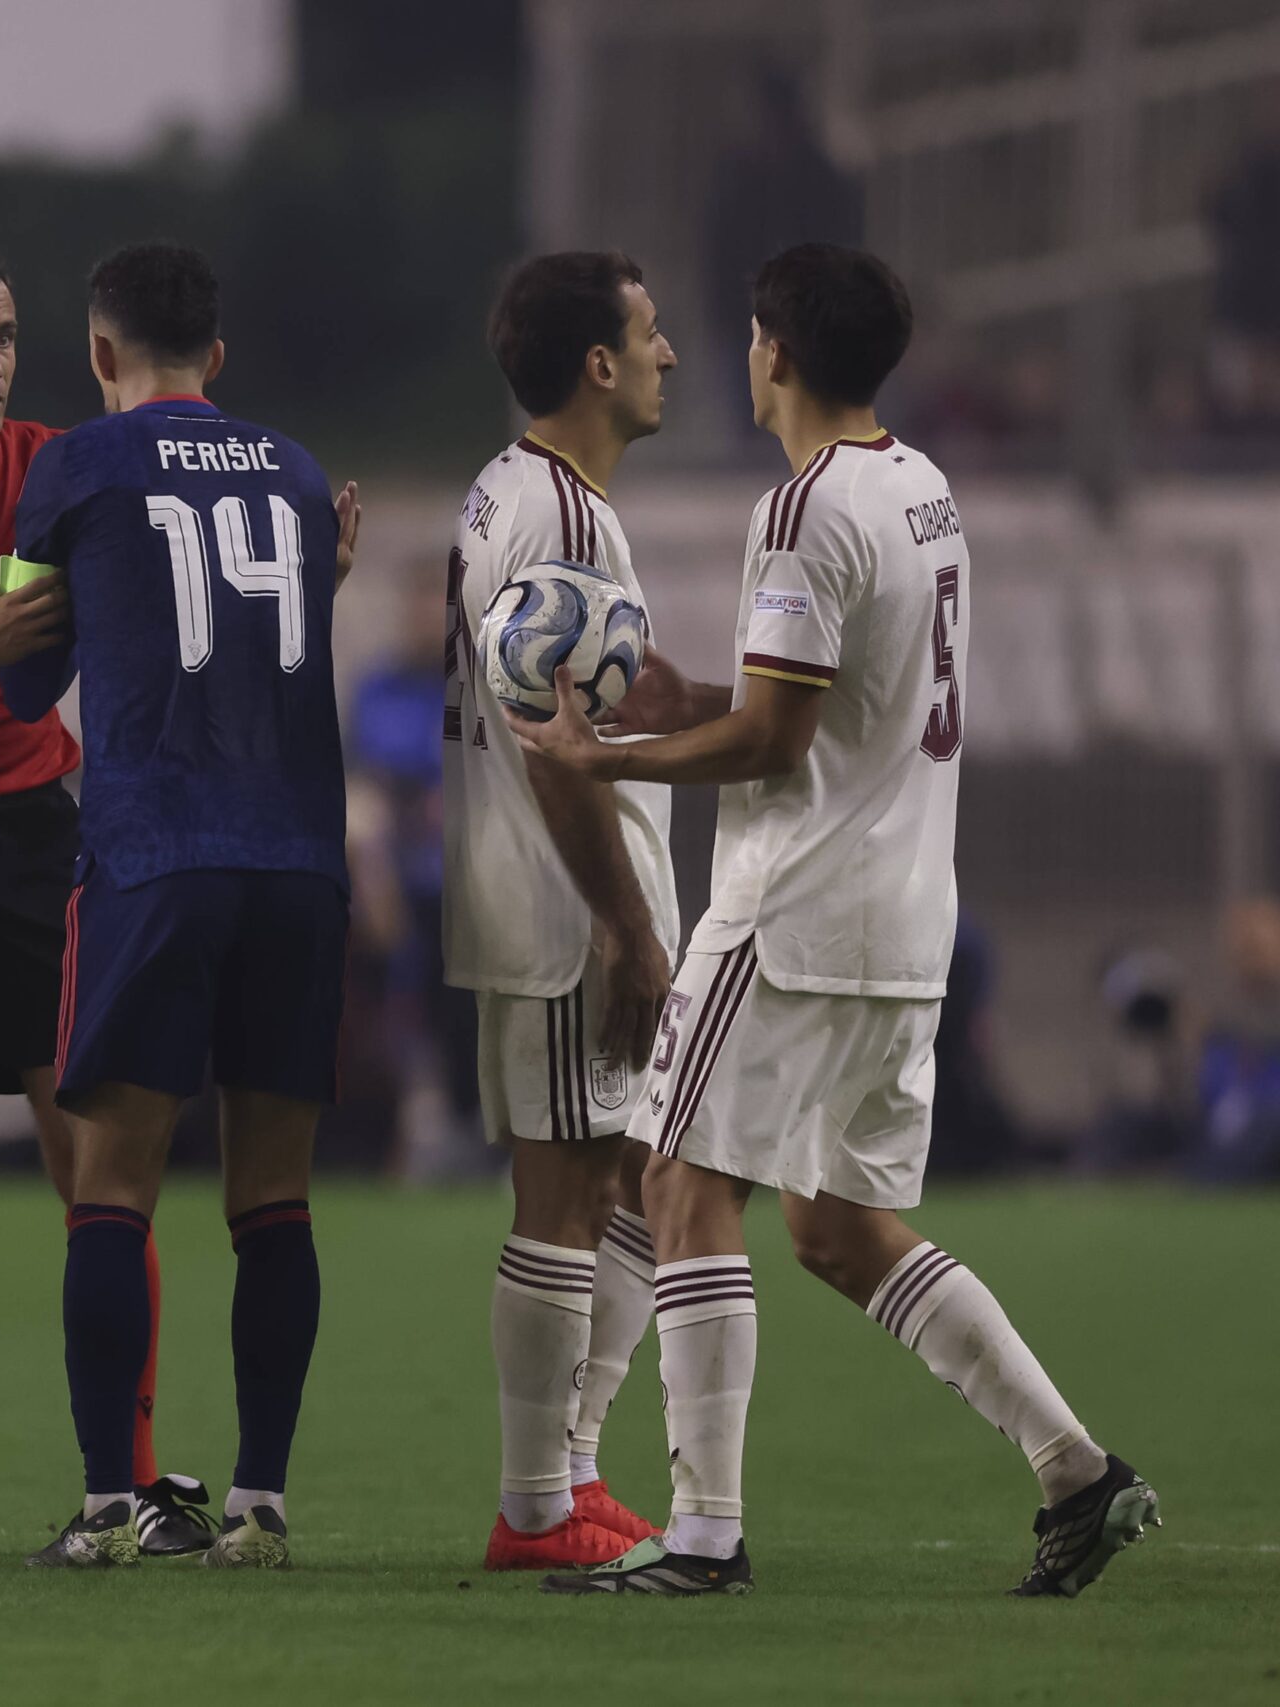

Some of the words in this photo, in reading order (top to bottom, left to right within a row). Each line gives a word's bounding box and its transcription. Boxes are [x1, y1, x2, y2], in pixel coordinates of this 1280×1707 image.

[157, 437, 280, 471] PERIŠIĆ
[905, 486, 960, 546] CUBARS
[145, 495, 304, 673] 14
[919, 564, 963, 763] 5
[652, 990, 693, 1074] 5
